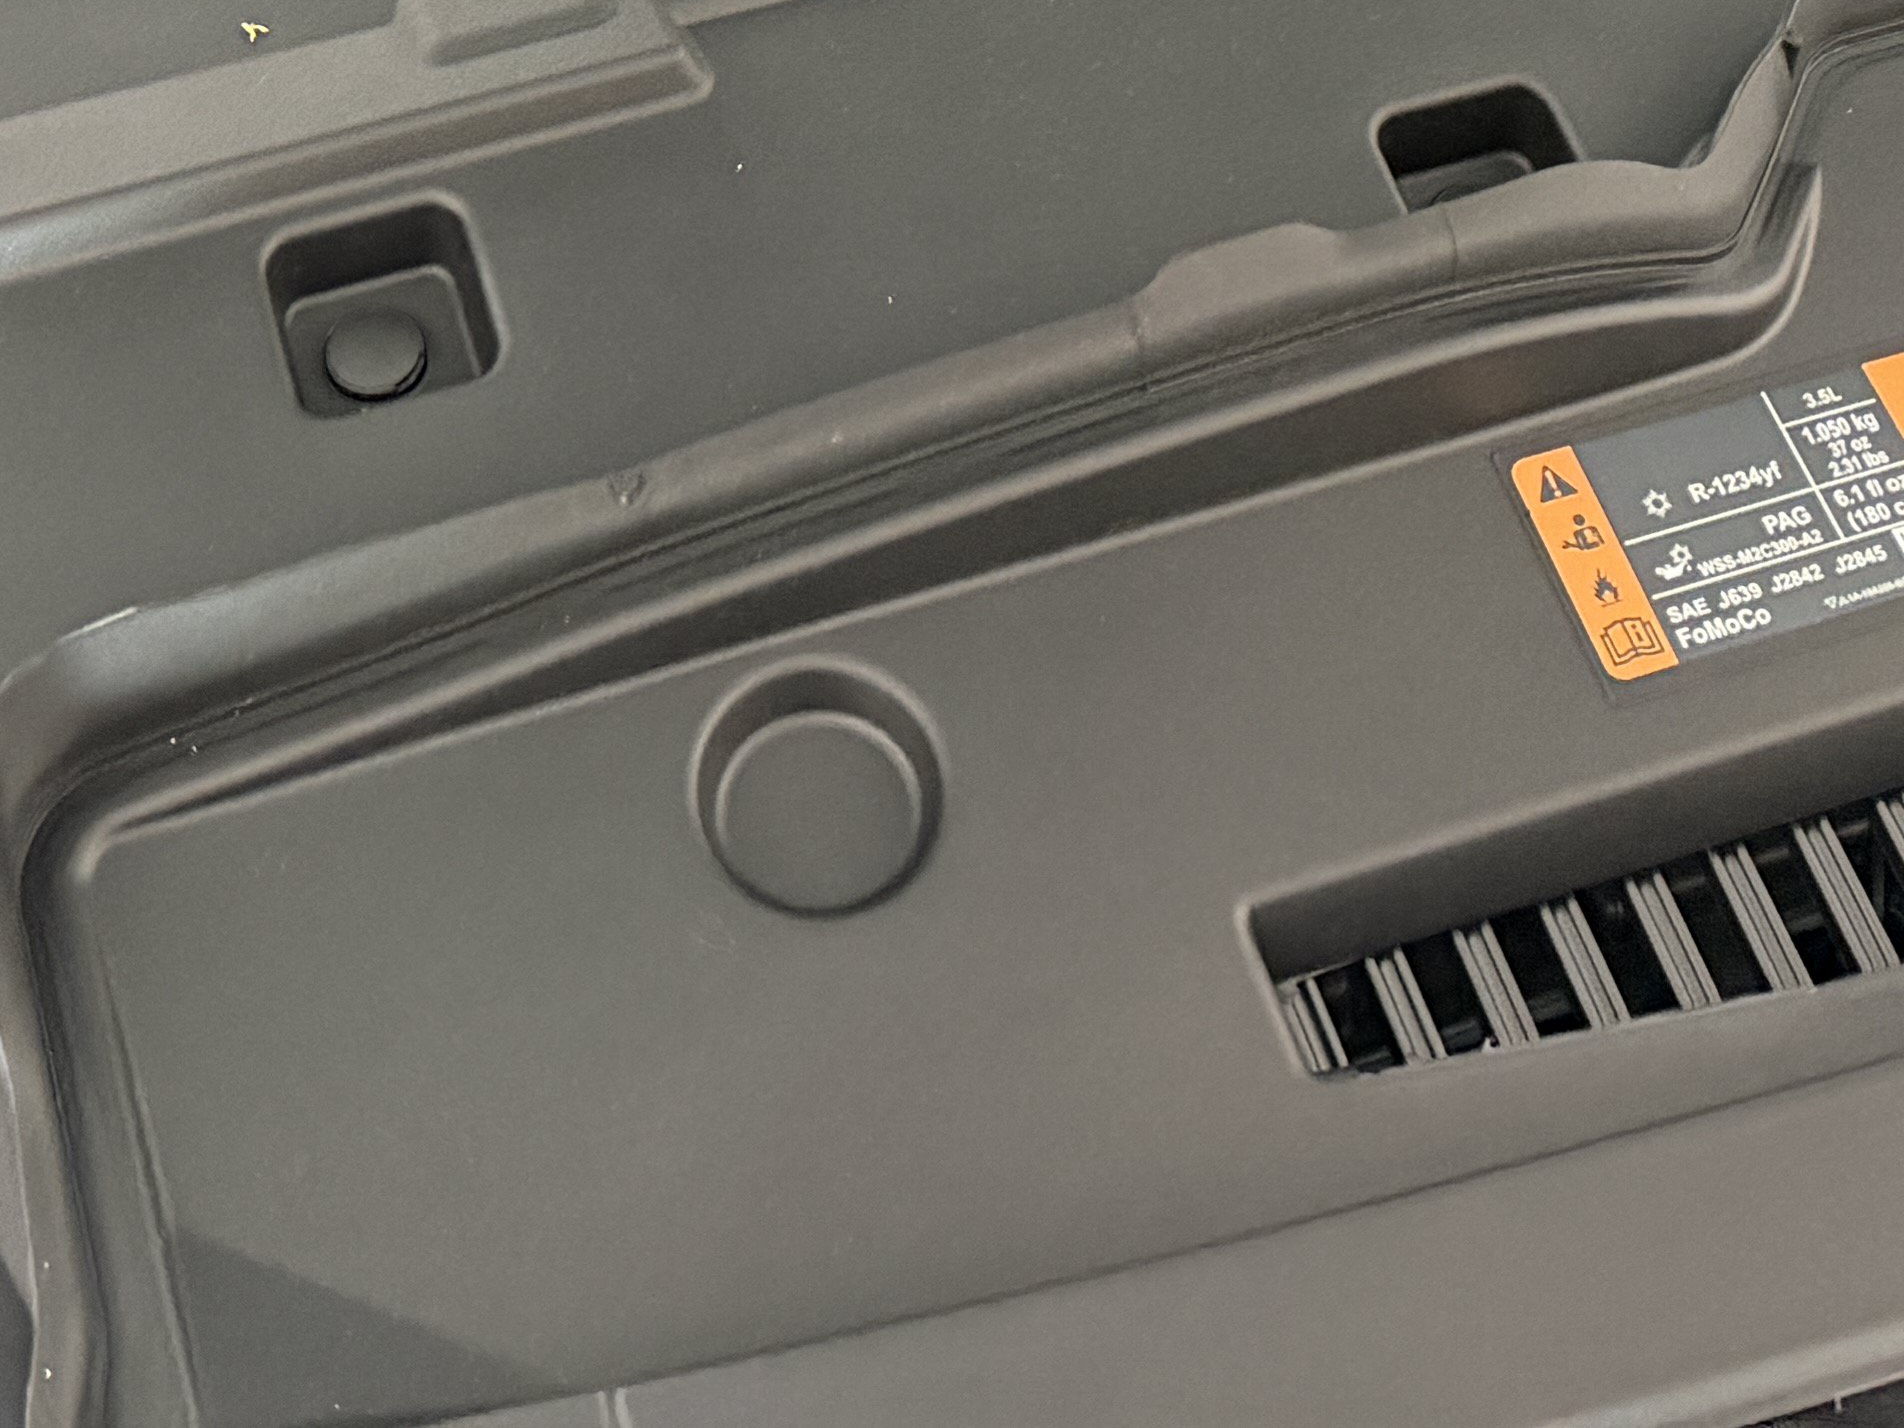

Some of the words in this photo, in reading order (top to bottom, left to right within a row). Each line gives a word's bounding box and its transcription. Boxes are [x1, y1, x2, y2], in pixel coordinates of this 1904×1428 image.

[1802, 387, 1843, 410] 3.5L
[1801, 418, 1850, 445] 1.050
[1852, 411, 1880, 438] kg
[1827, 439, 1848, 456] 37
[1850, 437, 1872, 451] oz
[1827, 457, 1859, 477] 2.31
[1860, 448, 1890, 470] lbs
[1687, 459, 1784, 504] R-1234yf
[1833, 482, 1865, 508] 6.1
[1760, 505, 1812, 534] PAG
[1845, 503, 1890, 535] (180
[1665, 595, 1709, 626] SAE
[1718, 582, 1764, 611] J639
[1770, 564, 1825, 597] J2842
[1833, 543, 1888, 577] J2845
[1675, 606, 1773, 650] FoMoCo
